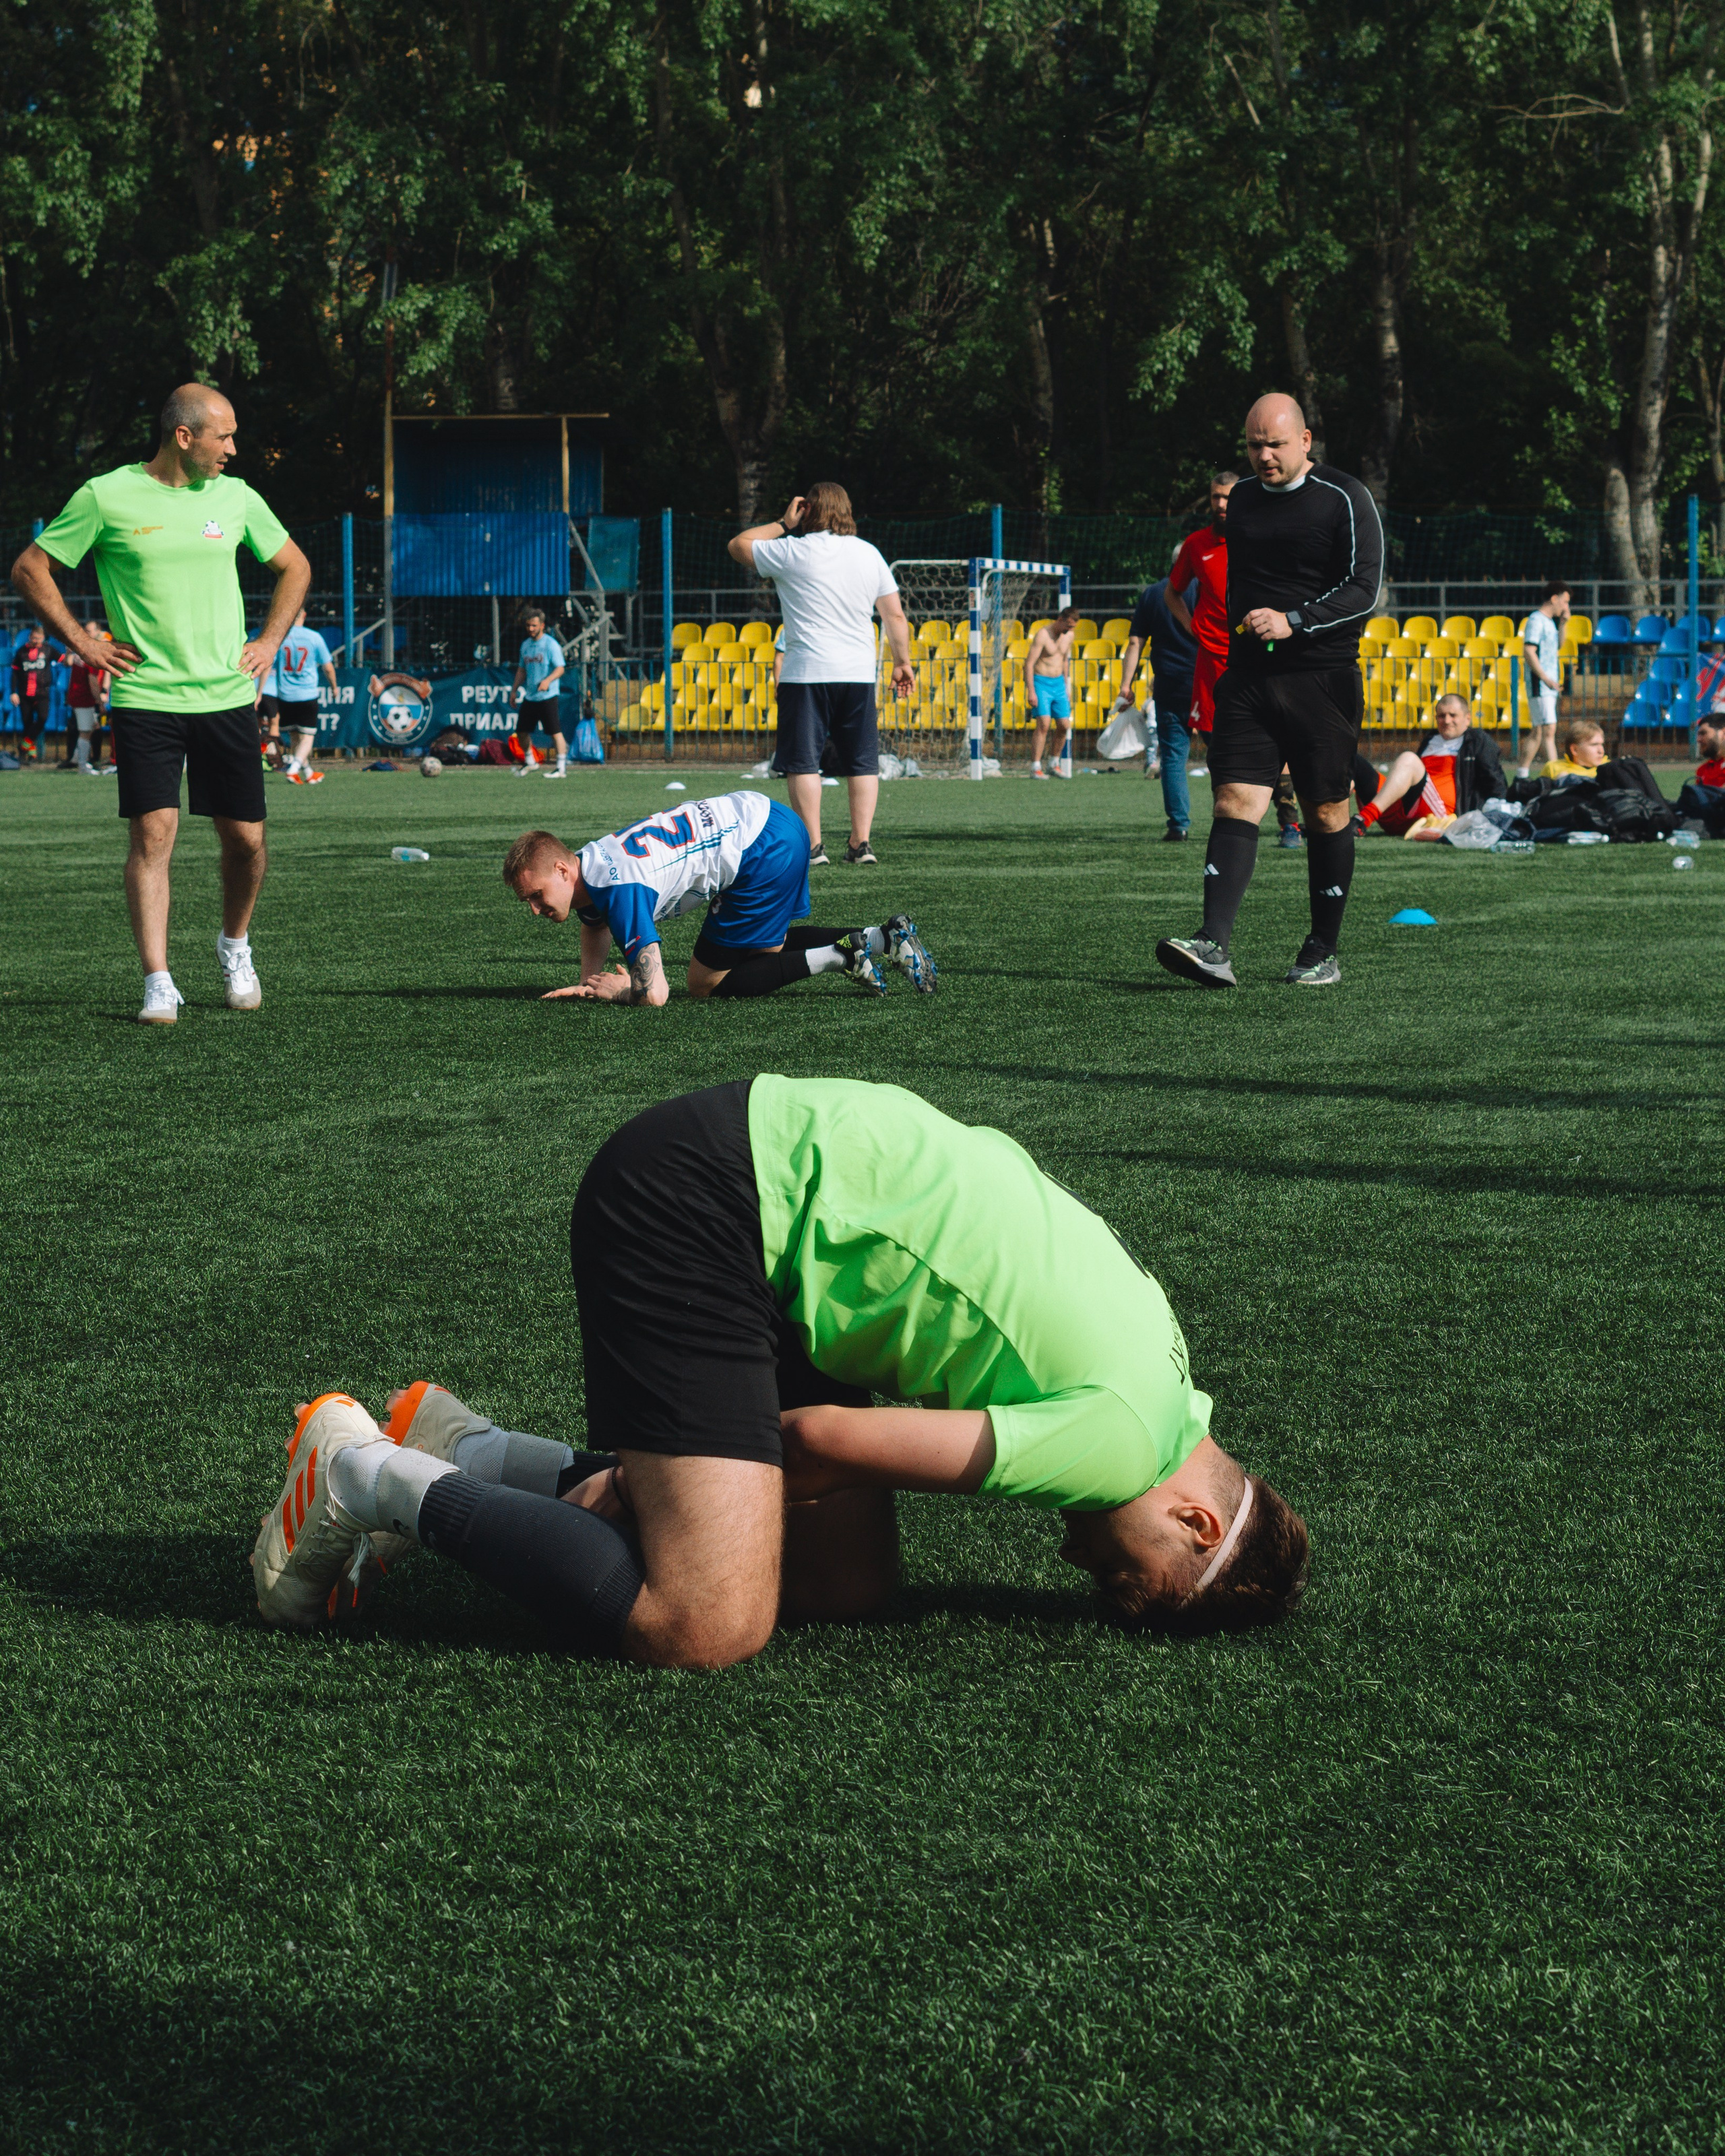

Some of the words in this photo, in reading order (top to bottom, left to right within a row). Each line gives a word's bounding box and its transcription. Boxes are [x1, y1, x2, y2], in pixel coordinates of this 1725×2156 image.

[284, 646, 308, 672] 17
[449, 713, 543, 731] ПРИАЛ
[1191, 701, 1200, 722] 4
[317, 714, 340, 731] Т?
[612, 804, 695, 859] 2
